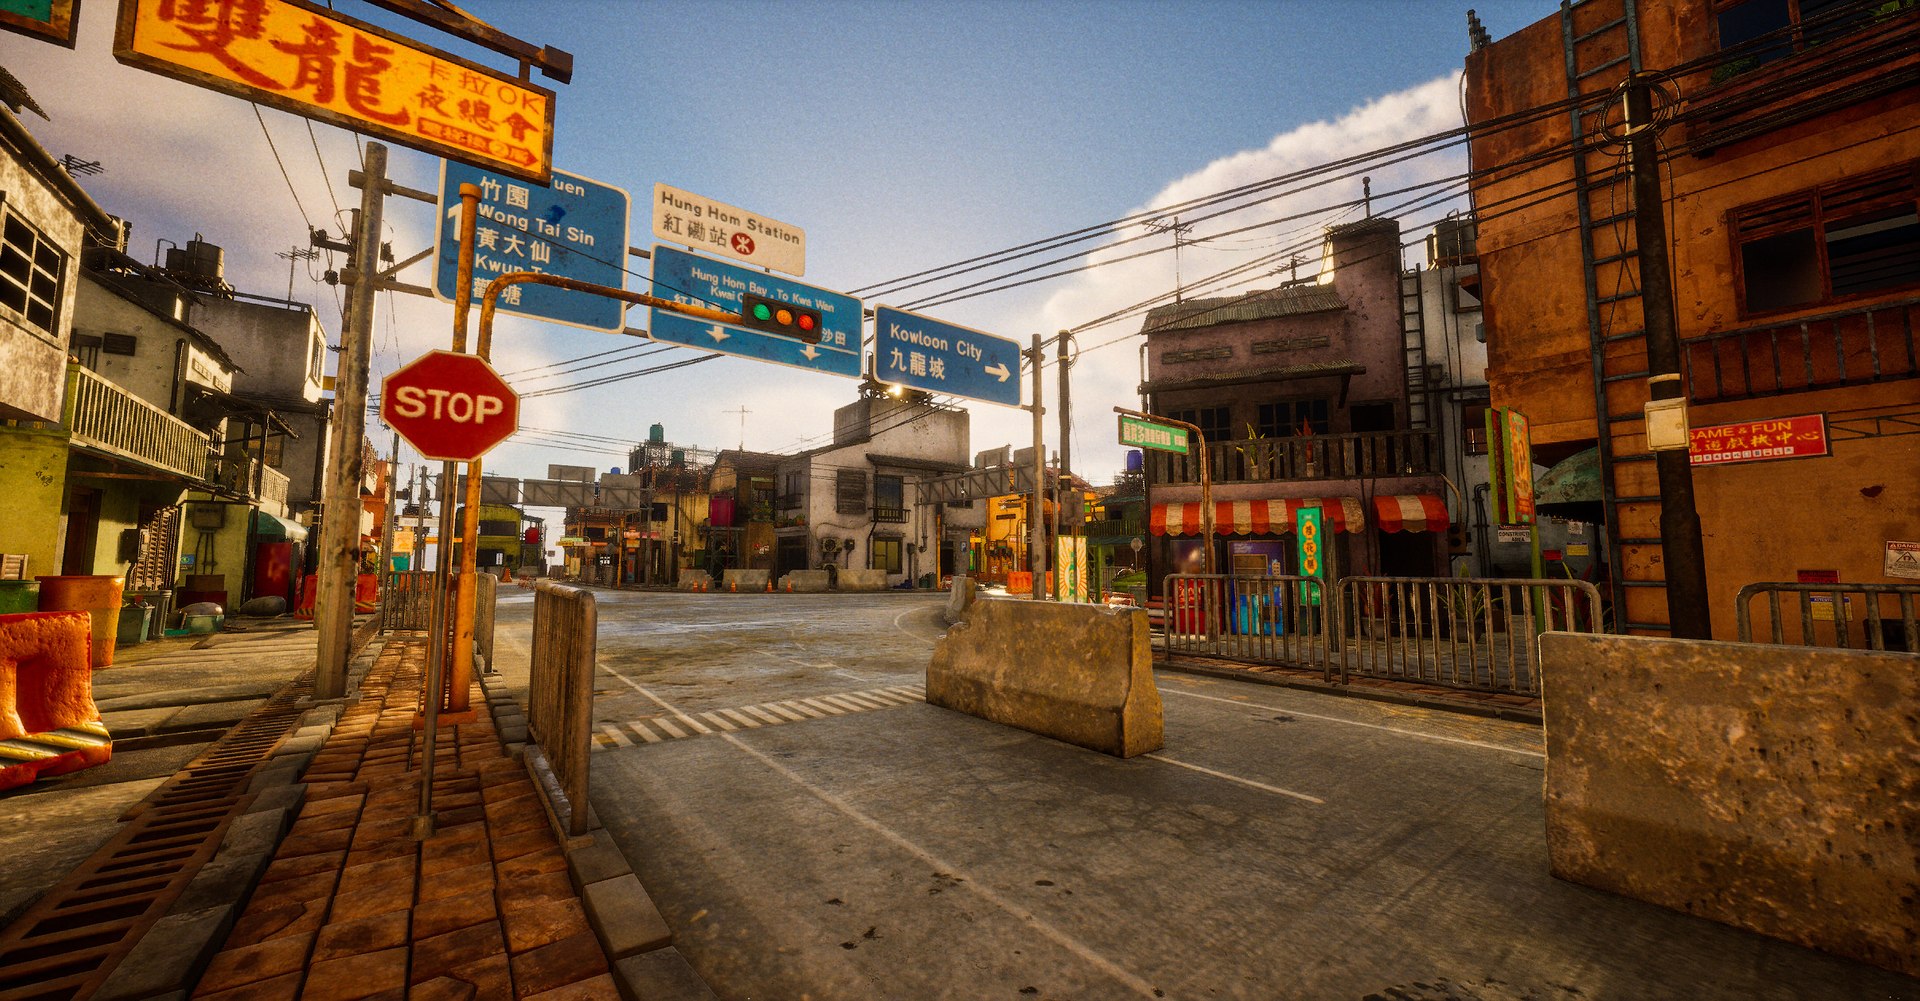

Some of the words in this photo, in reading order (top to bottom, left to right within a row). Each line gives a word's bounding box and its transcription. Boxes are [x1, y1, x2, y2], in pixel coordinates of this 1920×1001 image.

[480, 176, 530, 211] 竹園
[478, 203, 529, 232] Wong
[535, 218, 561, 238] Tai
[567, 226, 595, 247] Sin
[661, 191, 703, 218] Hung
[708, 205, 741, 227] Hom
[746, 218, 800, 245] Station
[662, 213, 728, 249] 紅磡站
[476, 226, 550, 264] 黃大仙
[691, 266, 719, 285] Hung
[722, 274, 747, 291] Hom
[776, 288, 789, 301] To
[792, 293, 813, 308] Kwa
[710, 286, 737, 300] Kwai
[890, 323, 949, 352] Kowloon
[956, 340, 983, 362] City
[889, 347, 946, 381] 九龍城
[394, 385, 504, 425] STOP
[1751, 421, 1793, 435] FUN
